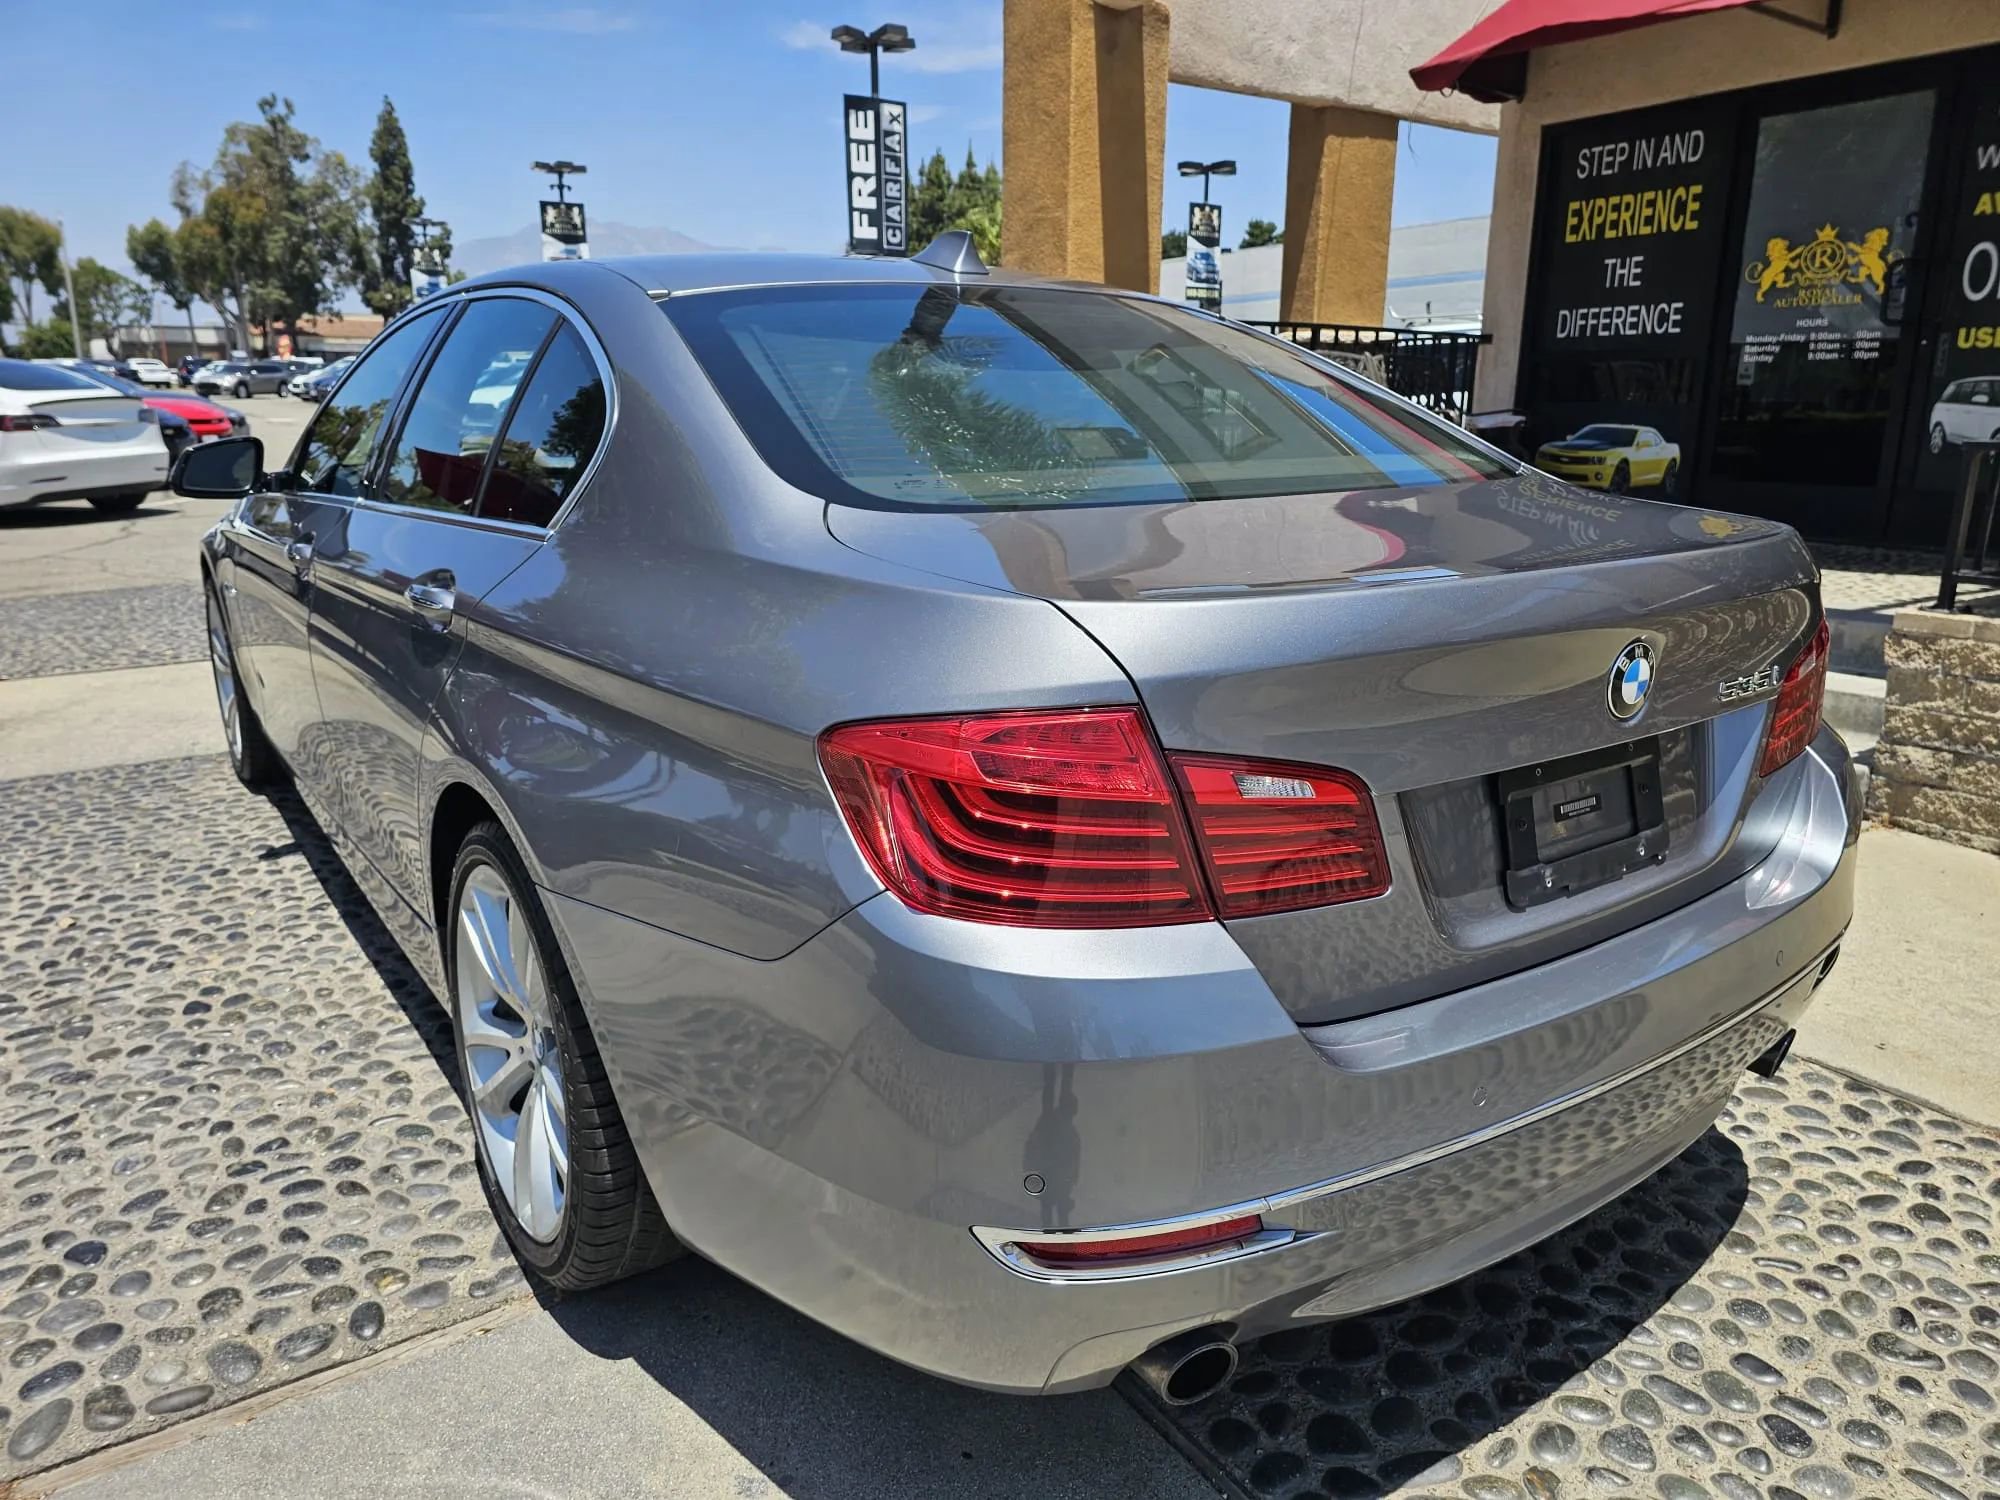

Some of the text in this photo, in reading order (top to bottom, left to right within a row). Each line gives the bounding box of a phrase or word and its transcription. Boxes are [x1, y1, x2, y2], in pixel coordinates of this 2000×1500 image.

[1576, 130, 1705, 179] STEP IN AND
[848, 108, 879, 240] FREE
[883, 108, 904, 246] CARFAX
[1564, 185, 1703, 243] EXPERIENCE
[1604, 256, 1645, 289] THE
[1773, 293, 1863, 308] AUTO DEALER
[1798, 287, 1839, 298] ROYAL
[1556, 302, 1684, 339] DIFFERENCE
[1796, 317, 1829, 328] HOURS
[1743, 353, 1774, 364] Sunday
[1744, 343, 1781, 353] Saturday
[1618, 644, 1654, 672] BMW
